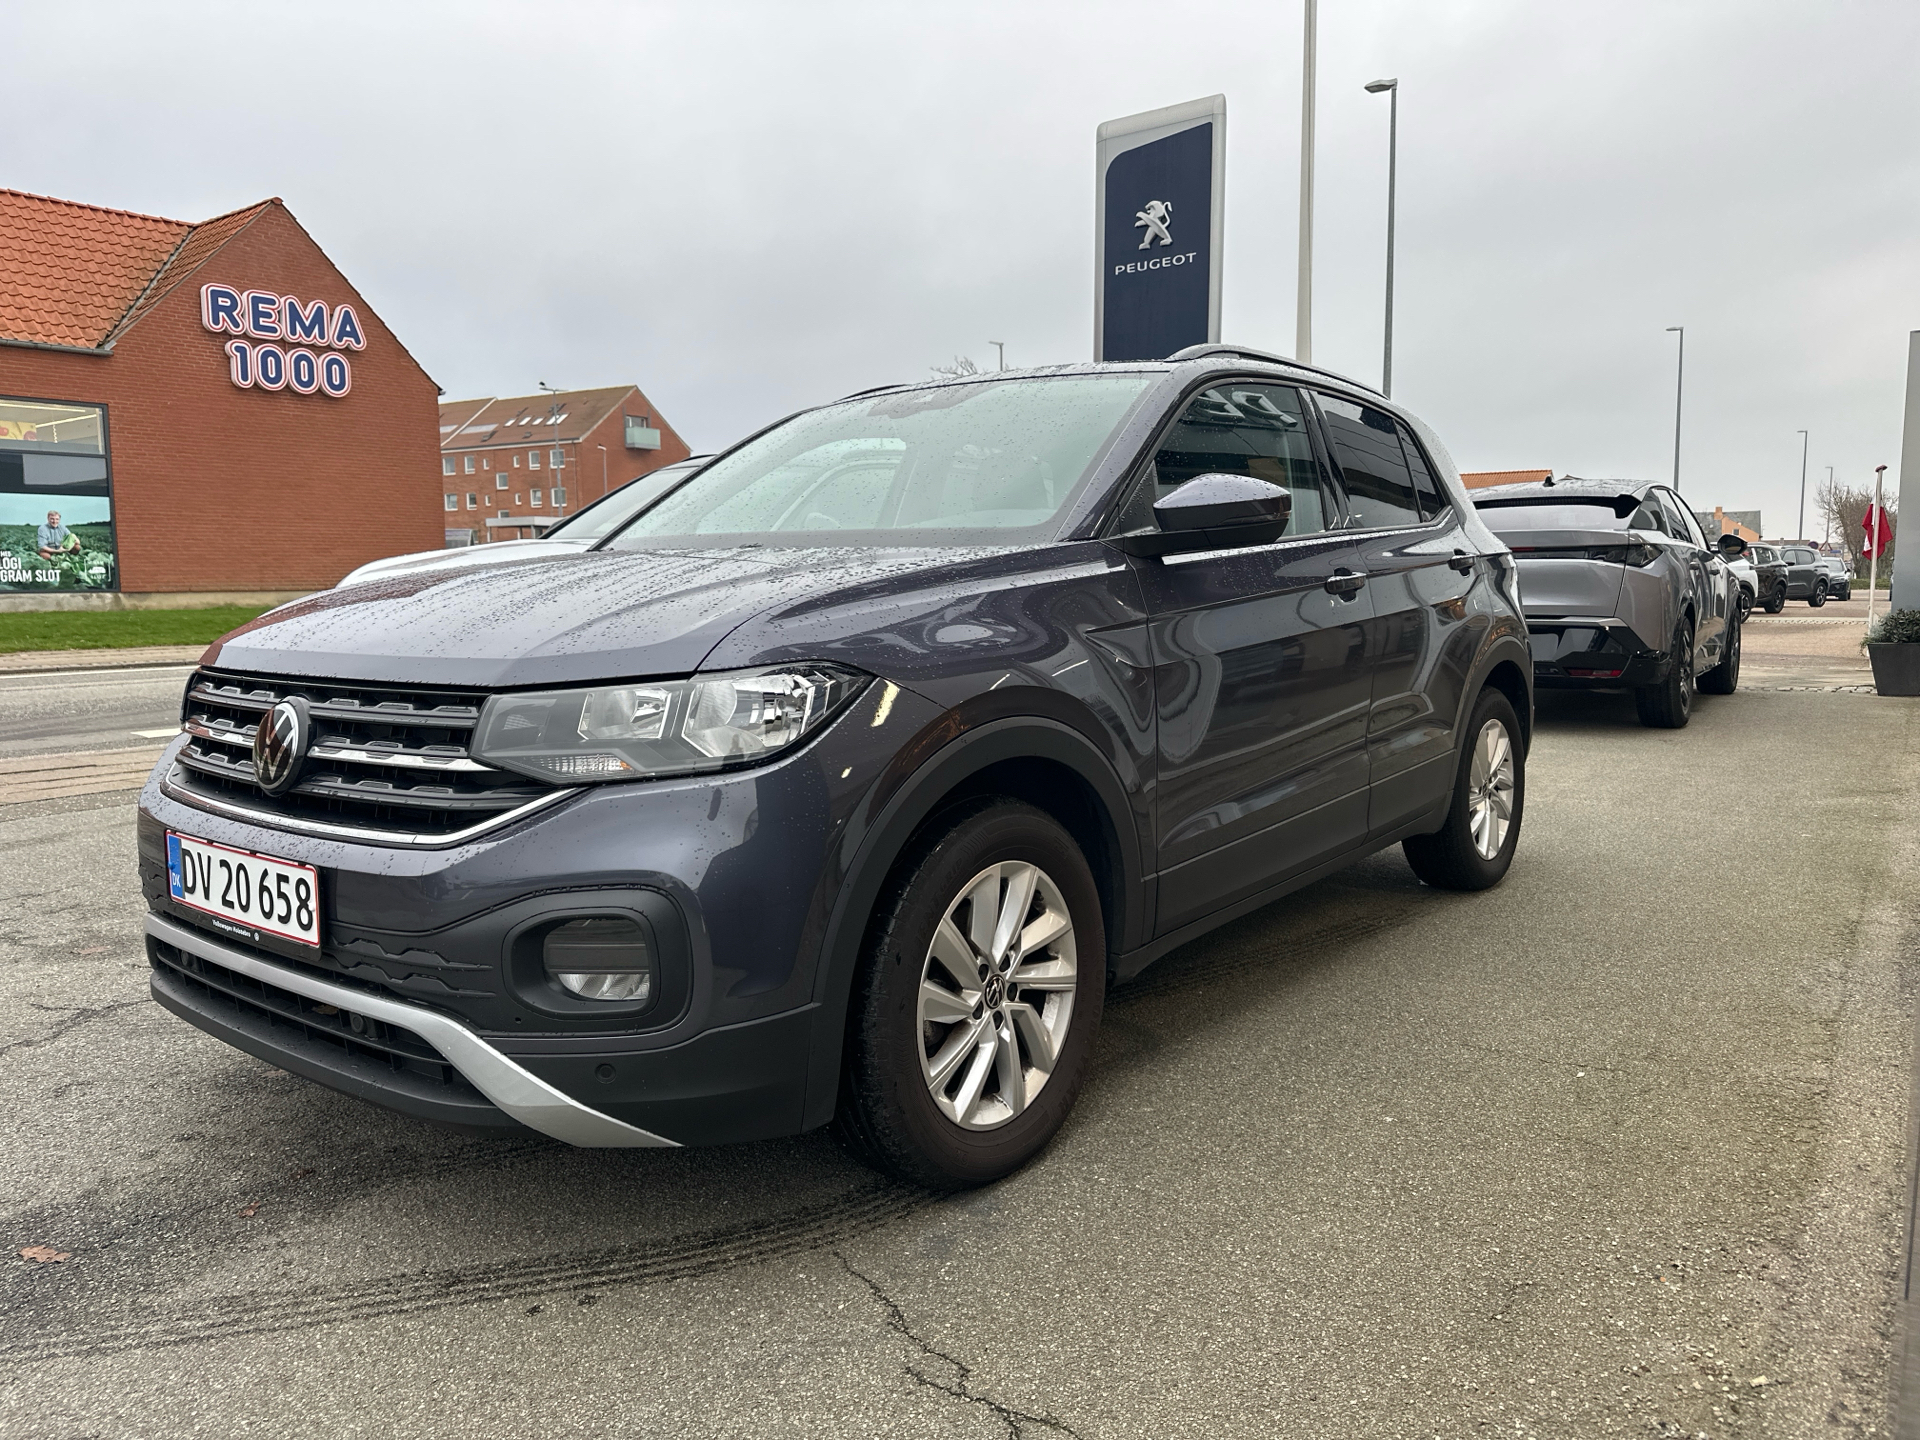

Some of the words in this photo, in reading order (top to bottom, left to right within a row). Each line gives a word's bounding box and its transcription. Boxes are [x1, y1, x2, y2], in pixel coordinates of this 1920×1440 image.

[1115, 252, 1197, 275] PEUGEOT
[201, 283, 367, 350] REMA
[226, 340, 352, 397] 1000
[0, 569, 32, 582] GRAM
[35, 569, 61, 582] SLOT
[172, 873, 181, 888] DK
[182, 848, 211, 900] DV
[219, 859, 251, 913] 20
[259, 868, 313, 931] 658
